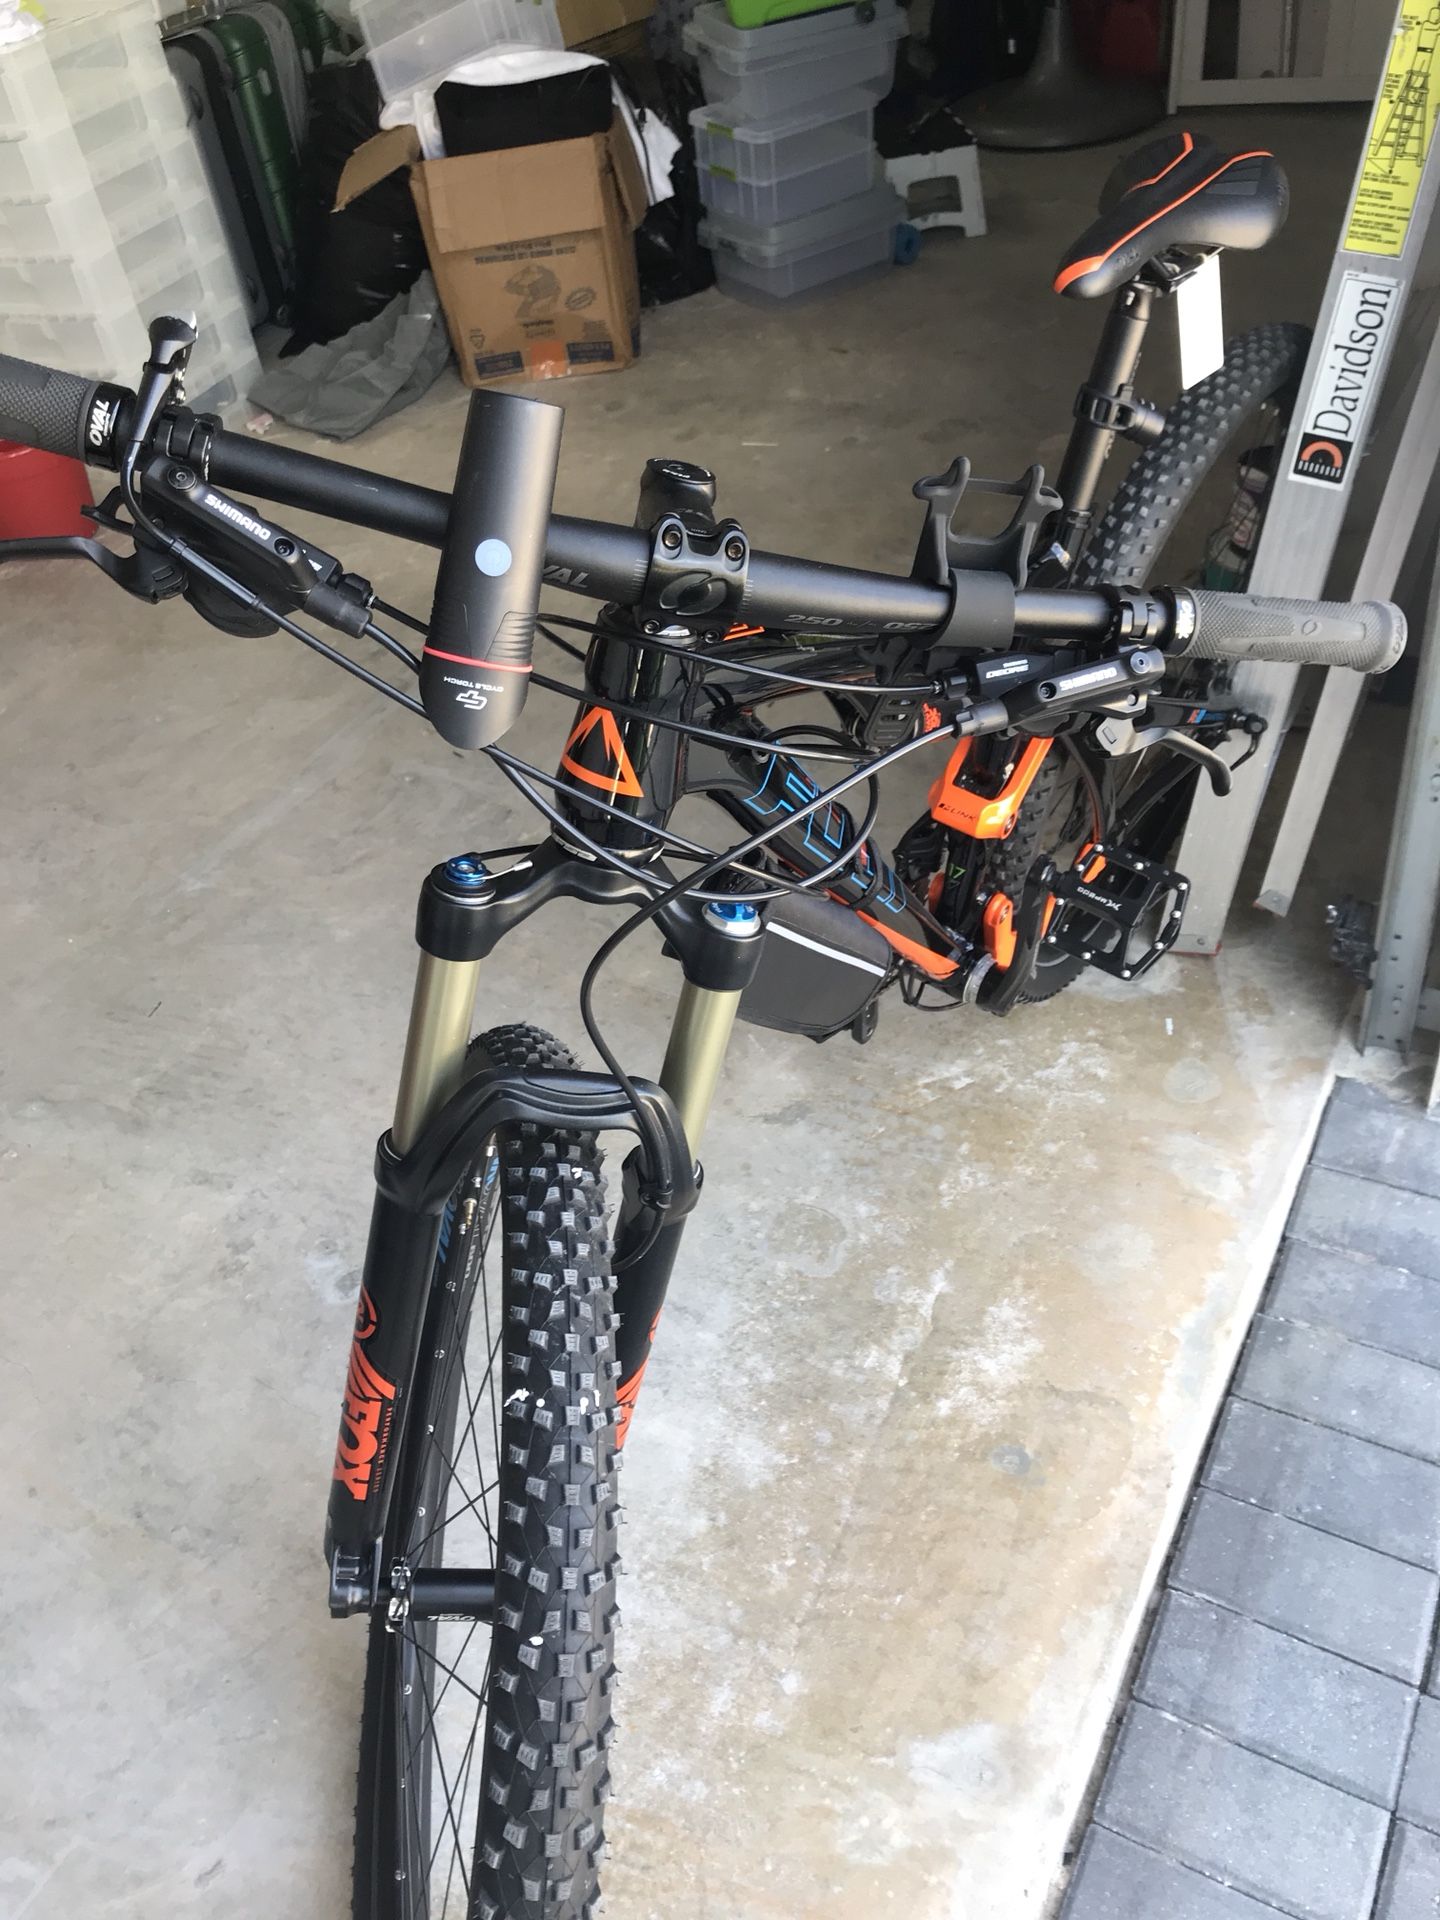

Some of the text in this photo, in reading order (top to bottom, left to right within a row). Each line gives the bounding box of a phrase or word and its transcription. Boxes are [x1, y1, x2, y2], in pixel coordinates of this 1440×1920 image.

[1312, 287, 1392, 438] Davidson
[89, 400, 110, 446] OVAL
[204, 493, 272, 541] SHIMANO
[333, 1400, 383, 1501] FOX
